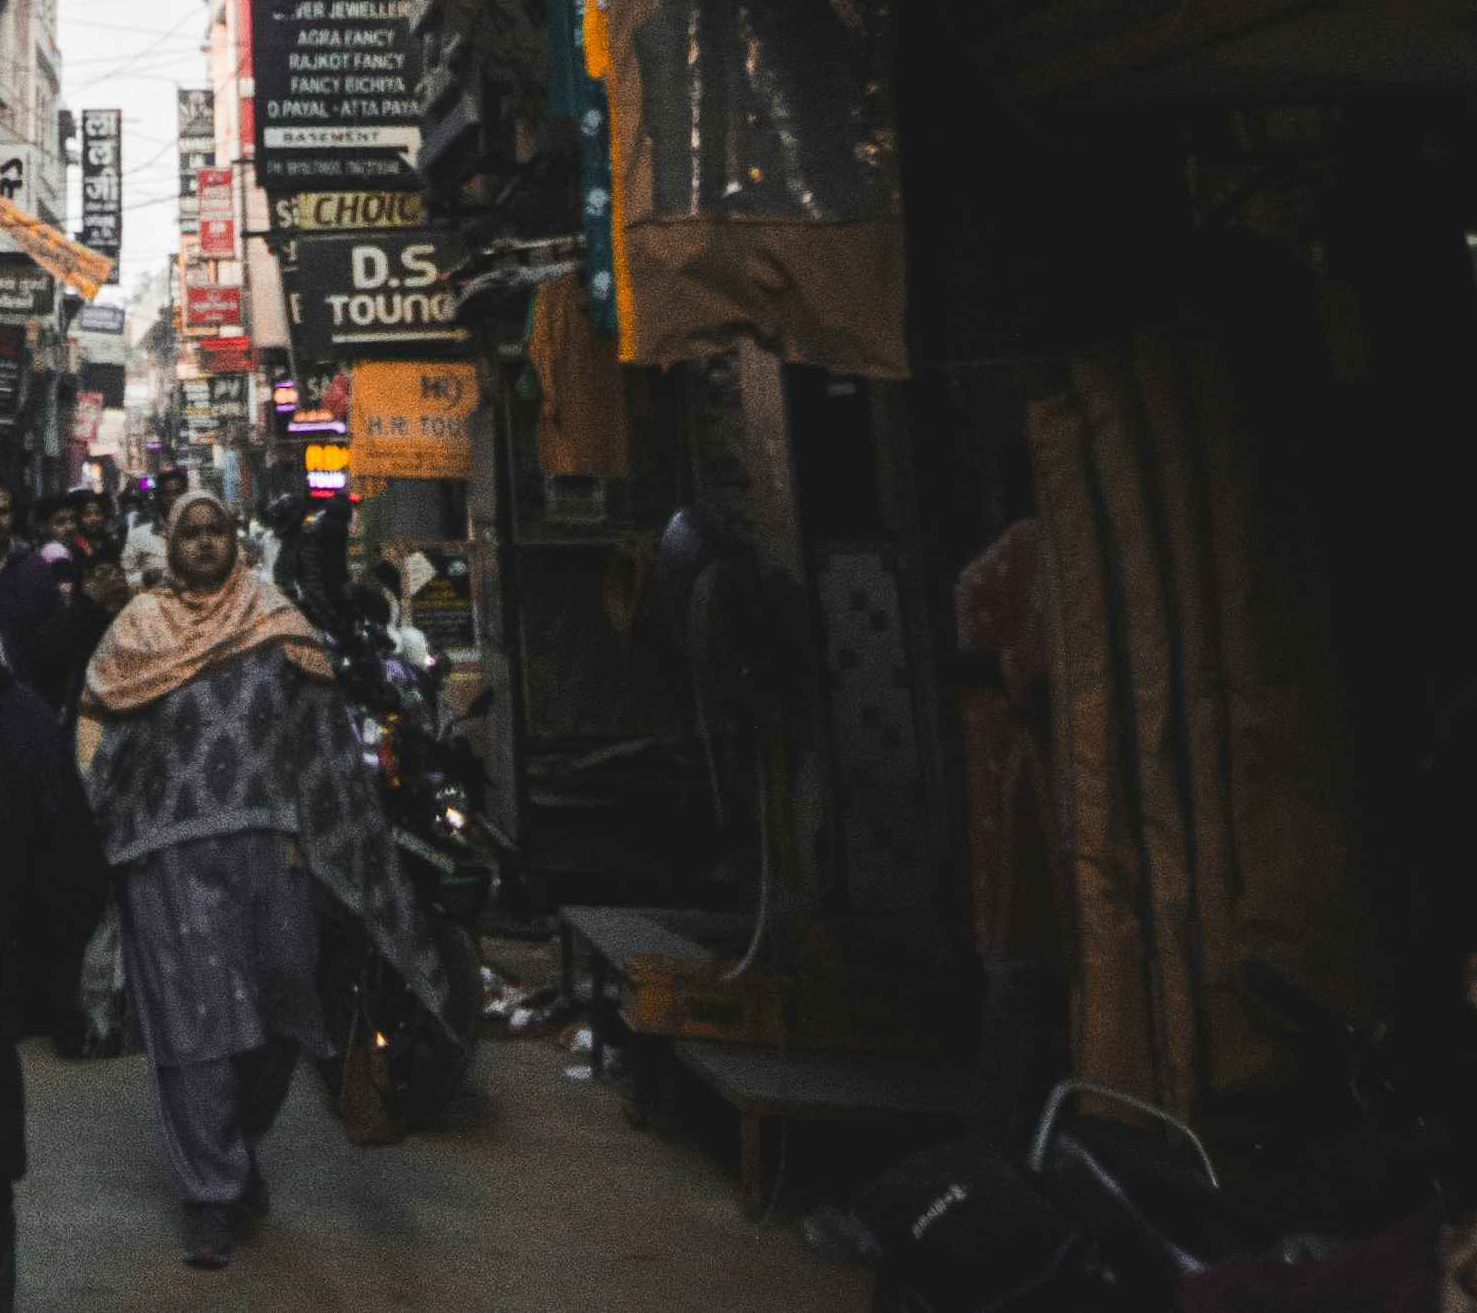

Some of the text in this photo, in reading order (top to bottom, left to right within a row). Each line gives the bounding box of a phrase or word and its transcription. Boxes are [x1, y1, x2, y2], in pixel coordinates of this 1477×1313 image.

[344, 28, 396, 47] FANCY
[353, 52, 406, 71] FANCY
[290, 75, 341, 95] FANCY
